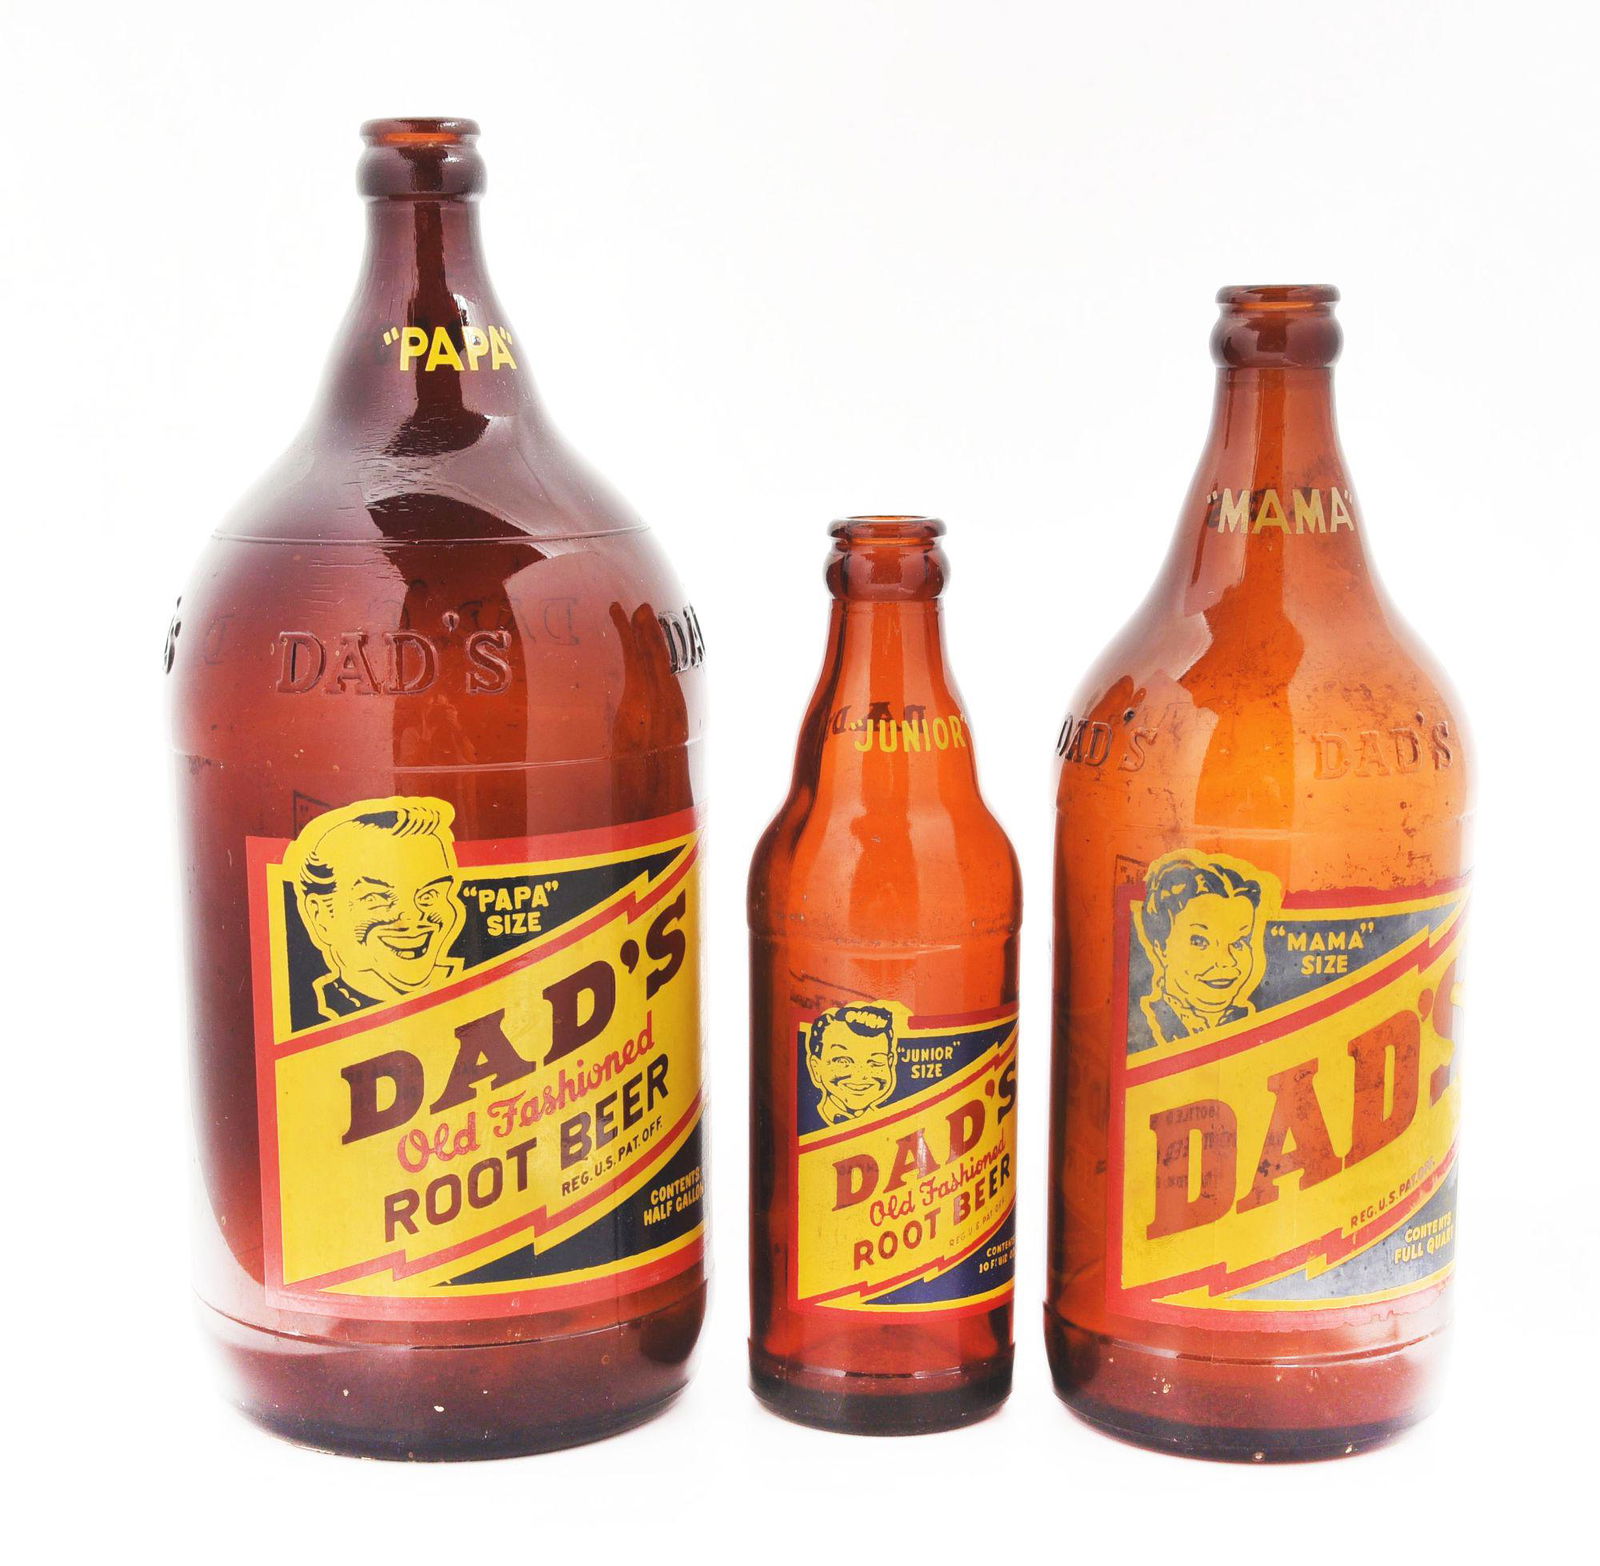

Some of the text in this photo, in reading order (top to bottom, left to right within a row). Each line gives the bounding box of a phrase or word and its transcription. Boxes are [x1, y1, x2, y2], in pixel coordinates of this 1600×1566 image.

[383, 325, 517, 371] "PAPA"
[1207, 487, 1355, 534] "MAMA"
[275, 610, 512, 695] DAD'S
[850, 713, 968, 752] "JUNIOR"
[1056, 707, 1159, 773] DAD'S
[1313, 711, 1453, 780] DAD'S
[462, 881, 559, 913] "PAPA"
[486, 912, 543, 937] SIZE
[1271, 922, 1374, 951] "MAMA"
[1301, 954, 1348, 975] SIZE
[340, 888, 687, 1144] DAD'S
[897, 1041, 960, 1063] "JUNIOR"
[911, 1065, 943, 1079] SIZE
[397, 1010, 655, 1173] Old Fashioned
[1146, 957, 1464, 1239] DAD'S
[384, 1053, 669, 1243] ROOT BEER
[562, 1116, 662, 1196] REG. U.S. PAT. OFF.
[832, 1055, 1016, 1212] DAD'S
[870, 1127, 1006, 1226] Old Fashioned
[643, 1200, 673, 1226] HALF
[853, 1153, 1011, 1272] ROOT BEER
[1351, 1205, 1377, 1228] REG.
[1379, 1190, 1398, 1211] U.S.
[1394, 1242, 1424, 1265] FULL
